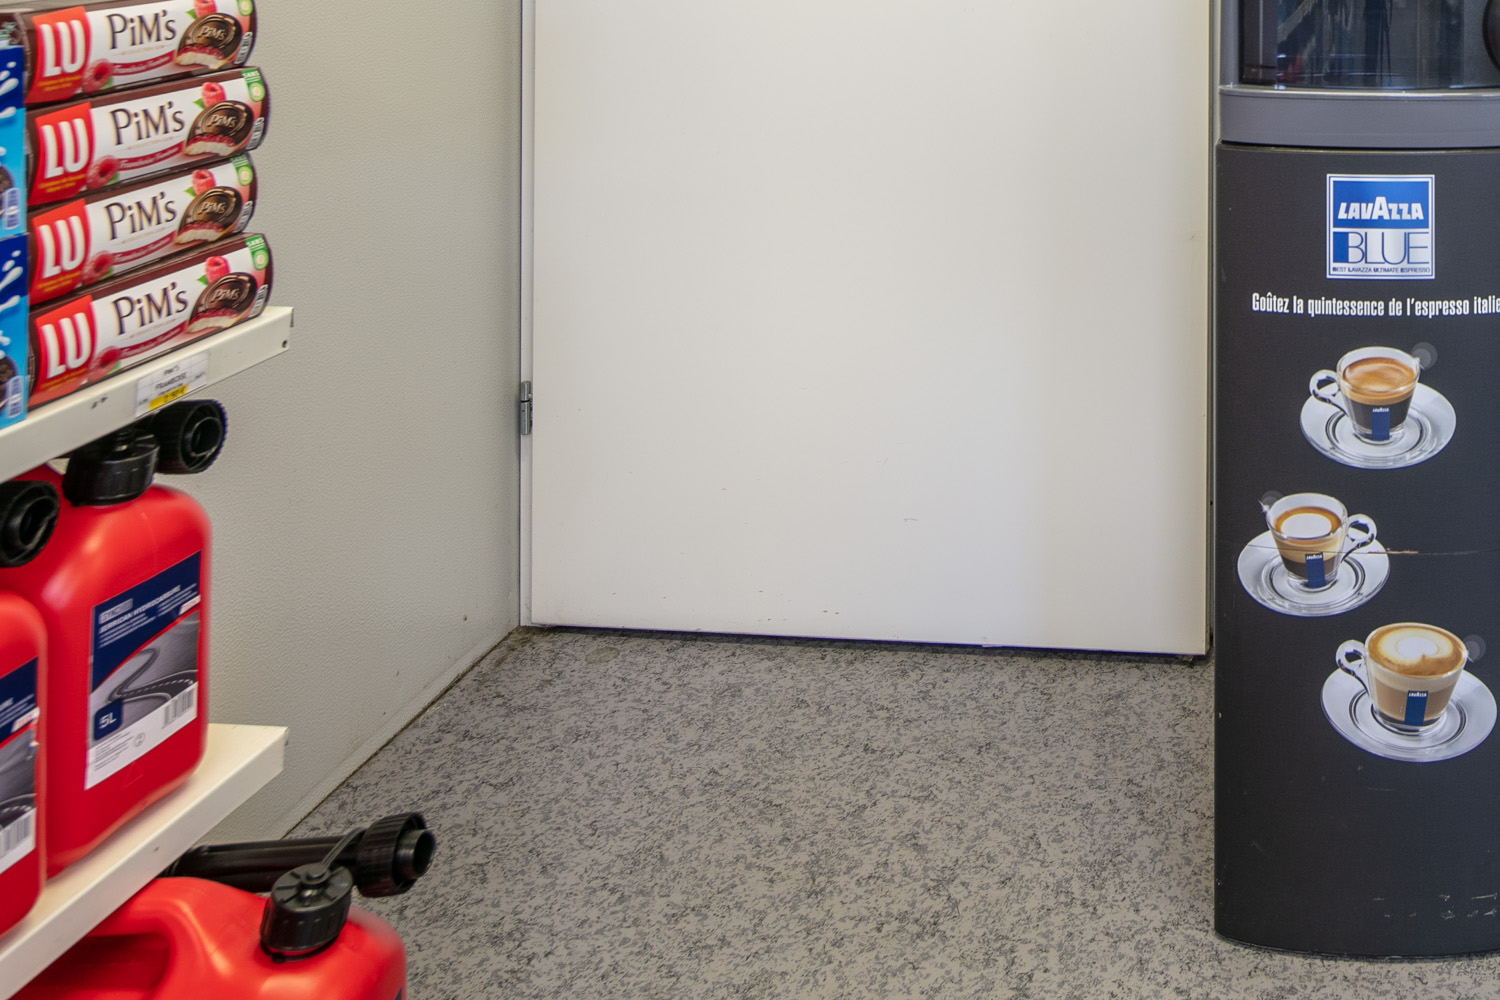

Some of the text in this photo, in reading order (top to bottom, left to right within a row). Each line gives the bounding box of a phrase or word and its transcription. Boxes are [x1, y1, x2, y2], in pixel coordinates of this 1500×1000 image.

[37, 18, 87, 79] LU
[106, 9, 178, 50] PiM's
[109, 101, 185, 147] PiM's
[40, 118, 90, 179] LU
[104, 192, 177, 242] PiM's
[1337, 196, 1425, 220] LAVAZZA
[38, 215, 87, 280] LU
[1346, 231, 1430, 264] BLUE
[112, 282, 188, 336] PiM's
[1251, 292, 1289, 314] Goûtez
[1293, 296, 1304, 314] la
[1307, 296, 1384, 317] quintessence
[1389, 298, 1403, 316] de
[1406, 297, 1470, 319] l'espresso
[40, 314, 92, 379] LU
[98, 711, 117, 729] 5L
